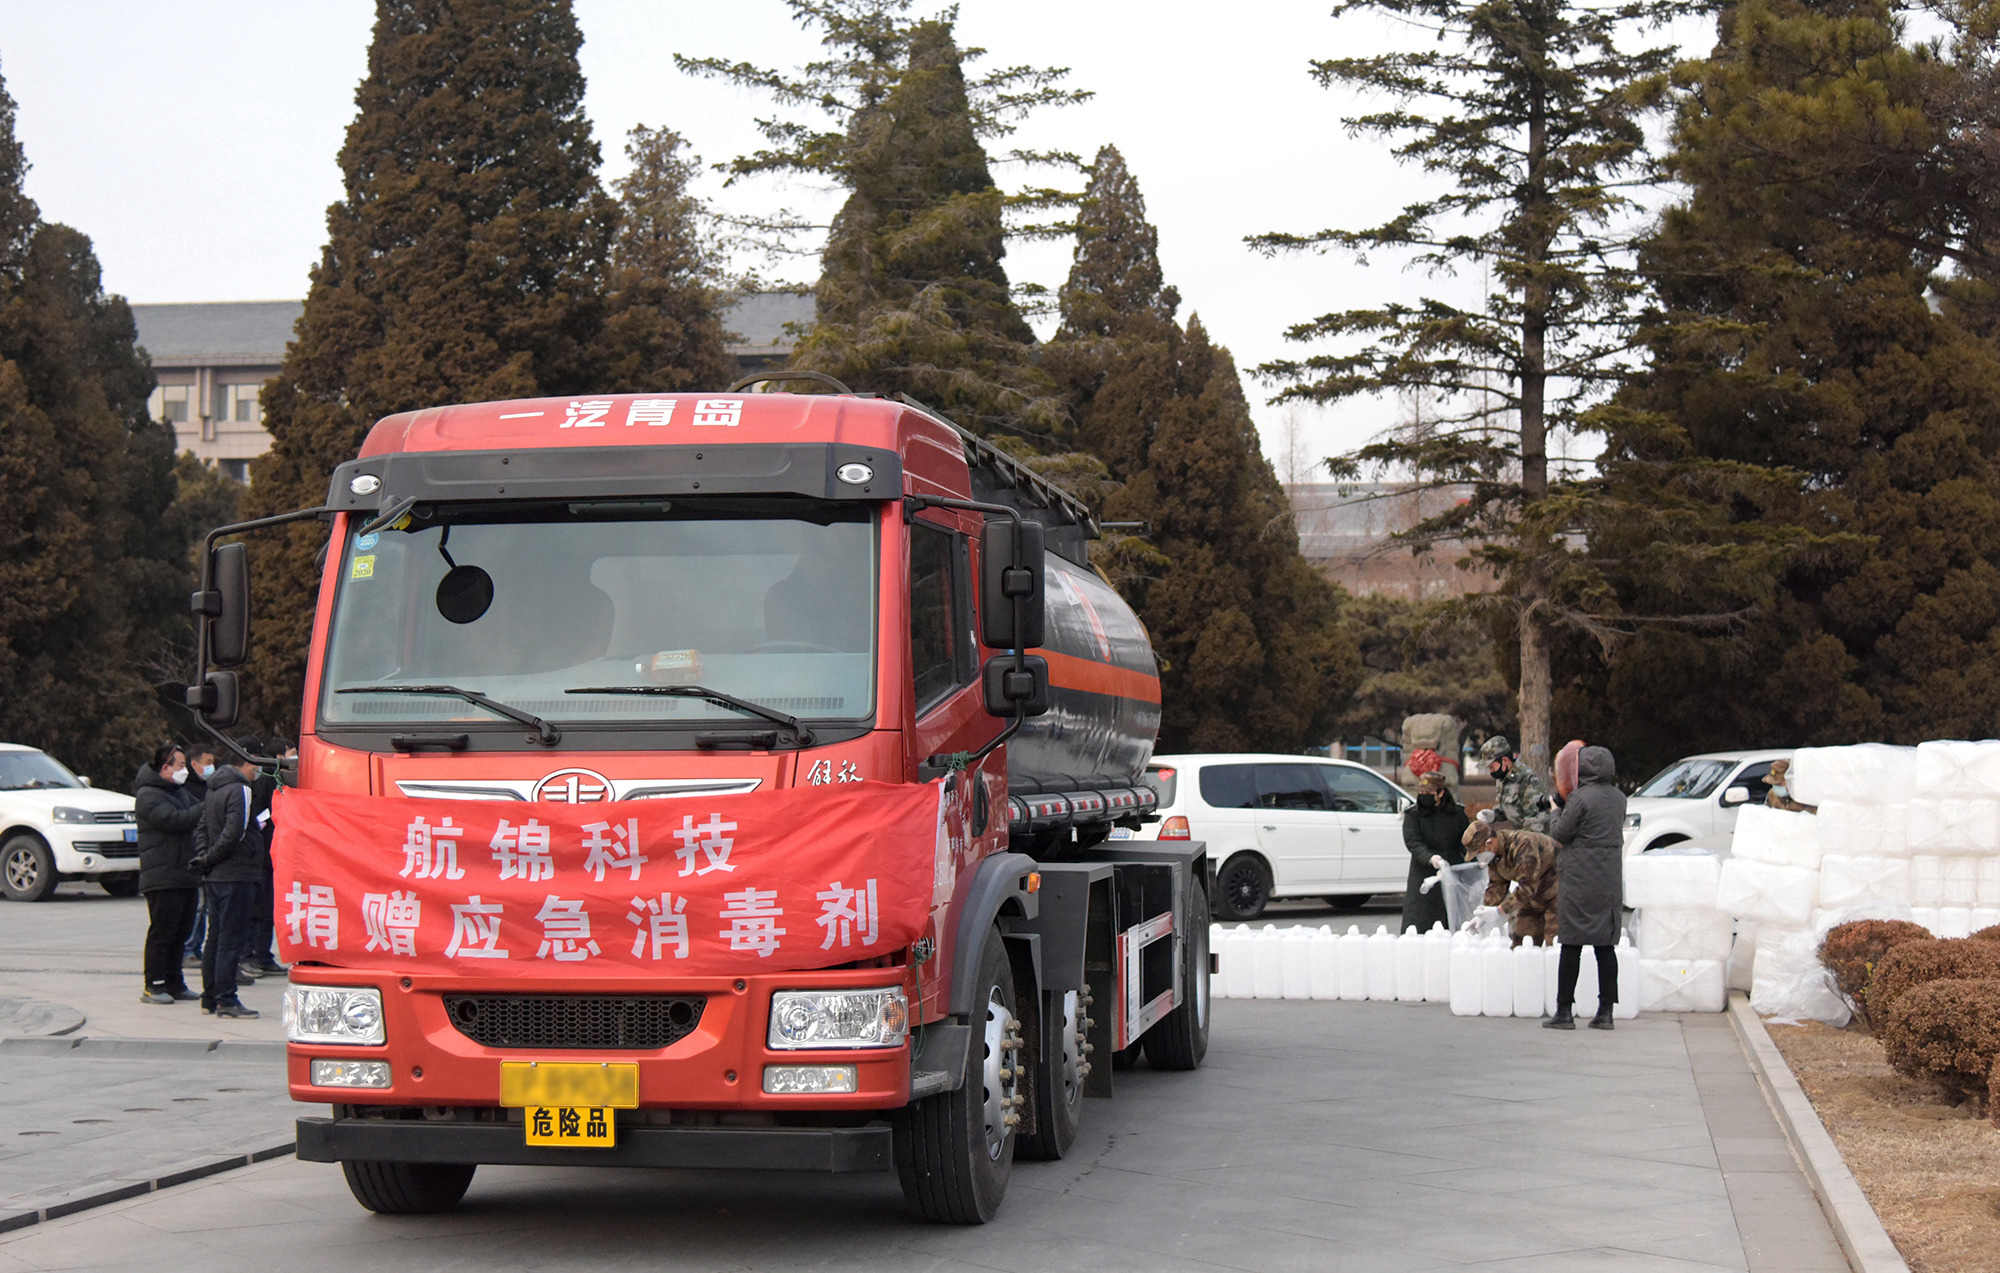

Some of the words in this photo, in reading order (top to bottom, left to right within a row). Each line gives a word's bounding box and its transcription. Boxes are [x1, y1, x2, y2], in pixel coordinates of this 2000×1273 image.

[499, 399, 744, 427] 一汽青岛
[807, 759, 864, 786] 解放
[401, 813, 738, 882] 航锦科技
[285, 877, 880, 961] 捐赠应急消毒剂
[532, 1108, 607, 1138] 危险品
